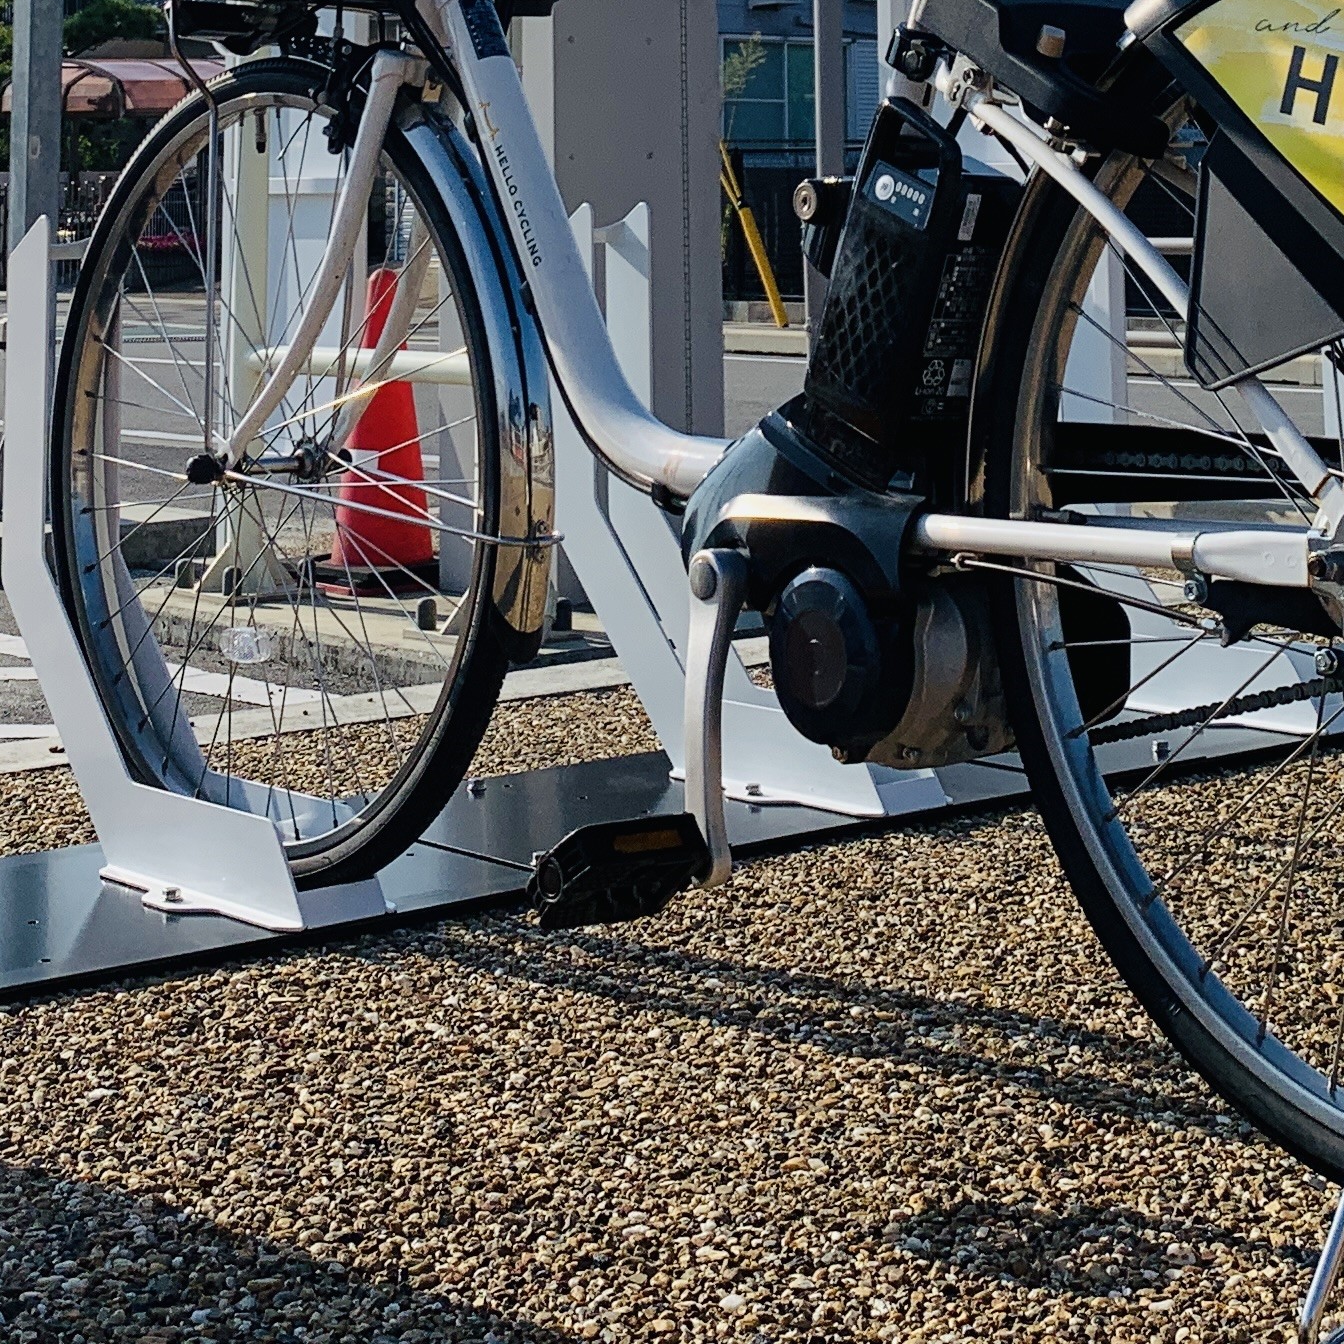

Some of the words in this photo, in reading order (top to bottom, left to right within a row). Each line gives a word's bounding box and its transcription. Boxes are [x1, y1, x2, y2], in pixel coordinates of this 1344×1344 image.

[1254, 8, 1342, 35] and
[494, 143, 519, 197] HELLO
[512, 199, 543, 268] CYCLING
